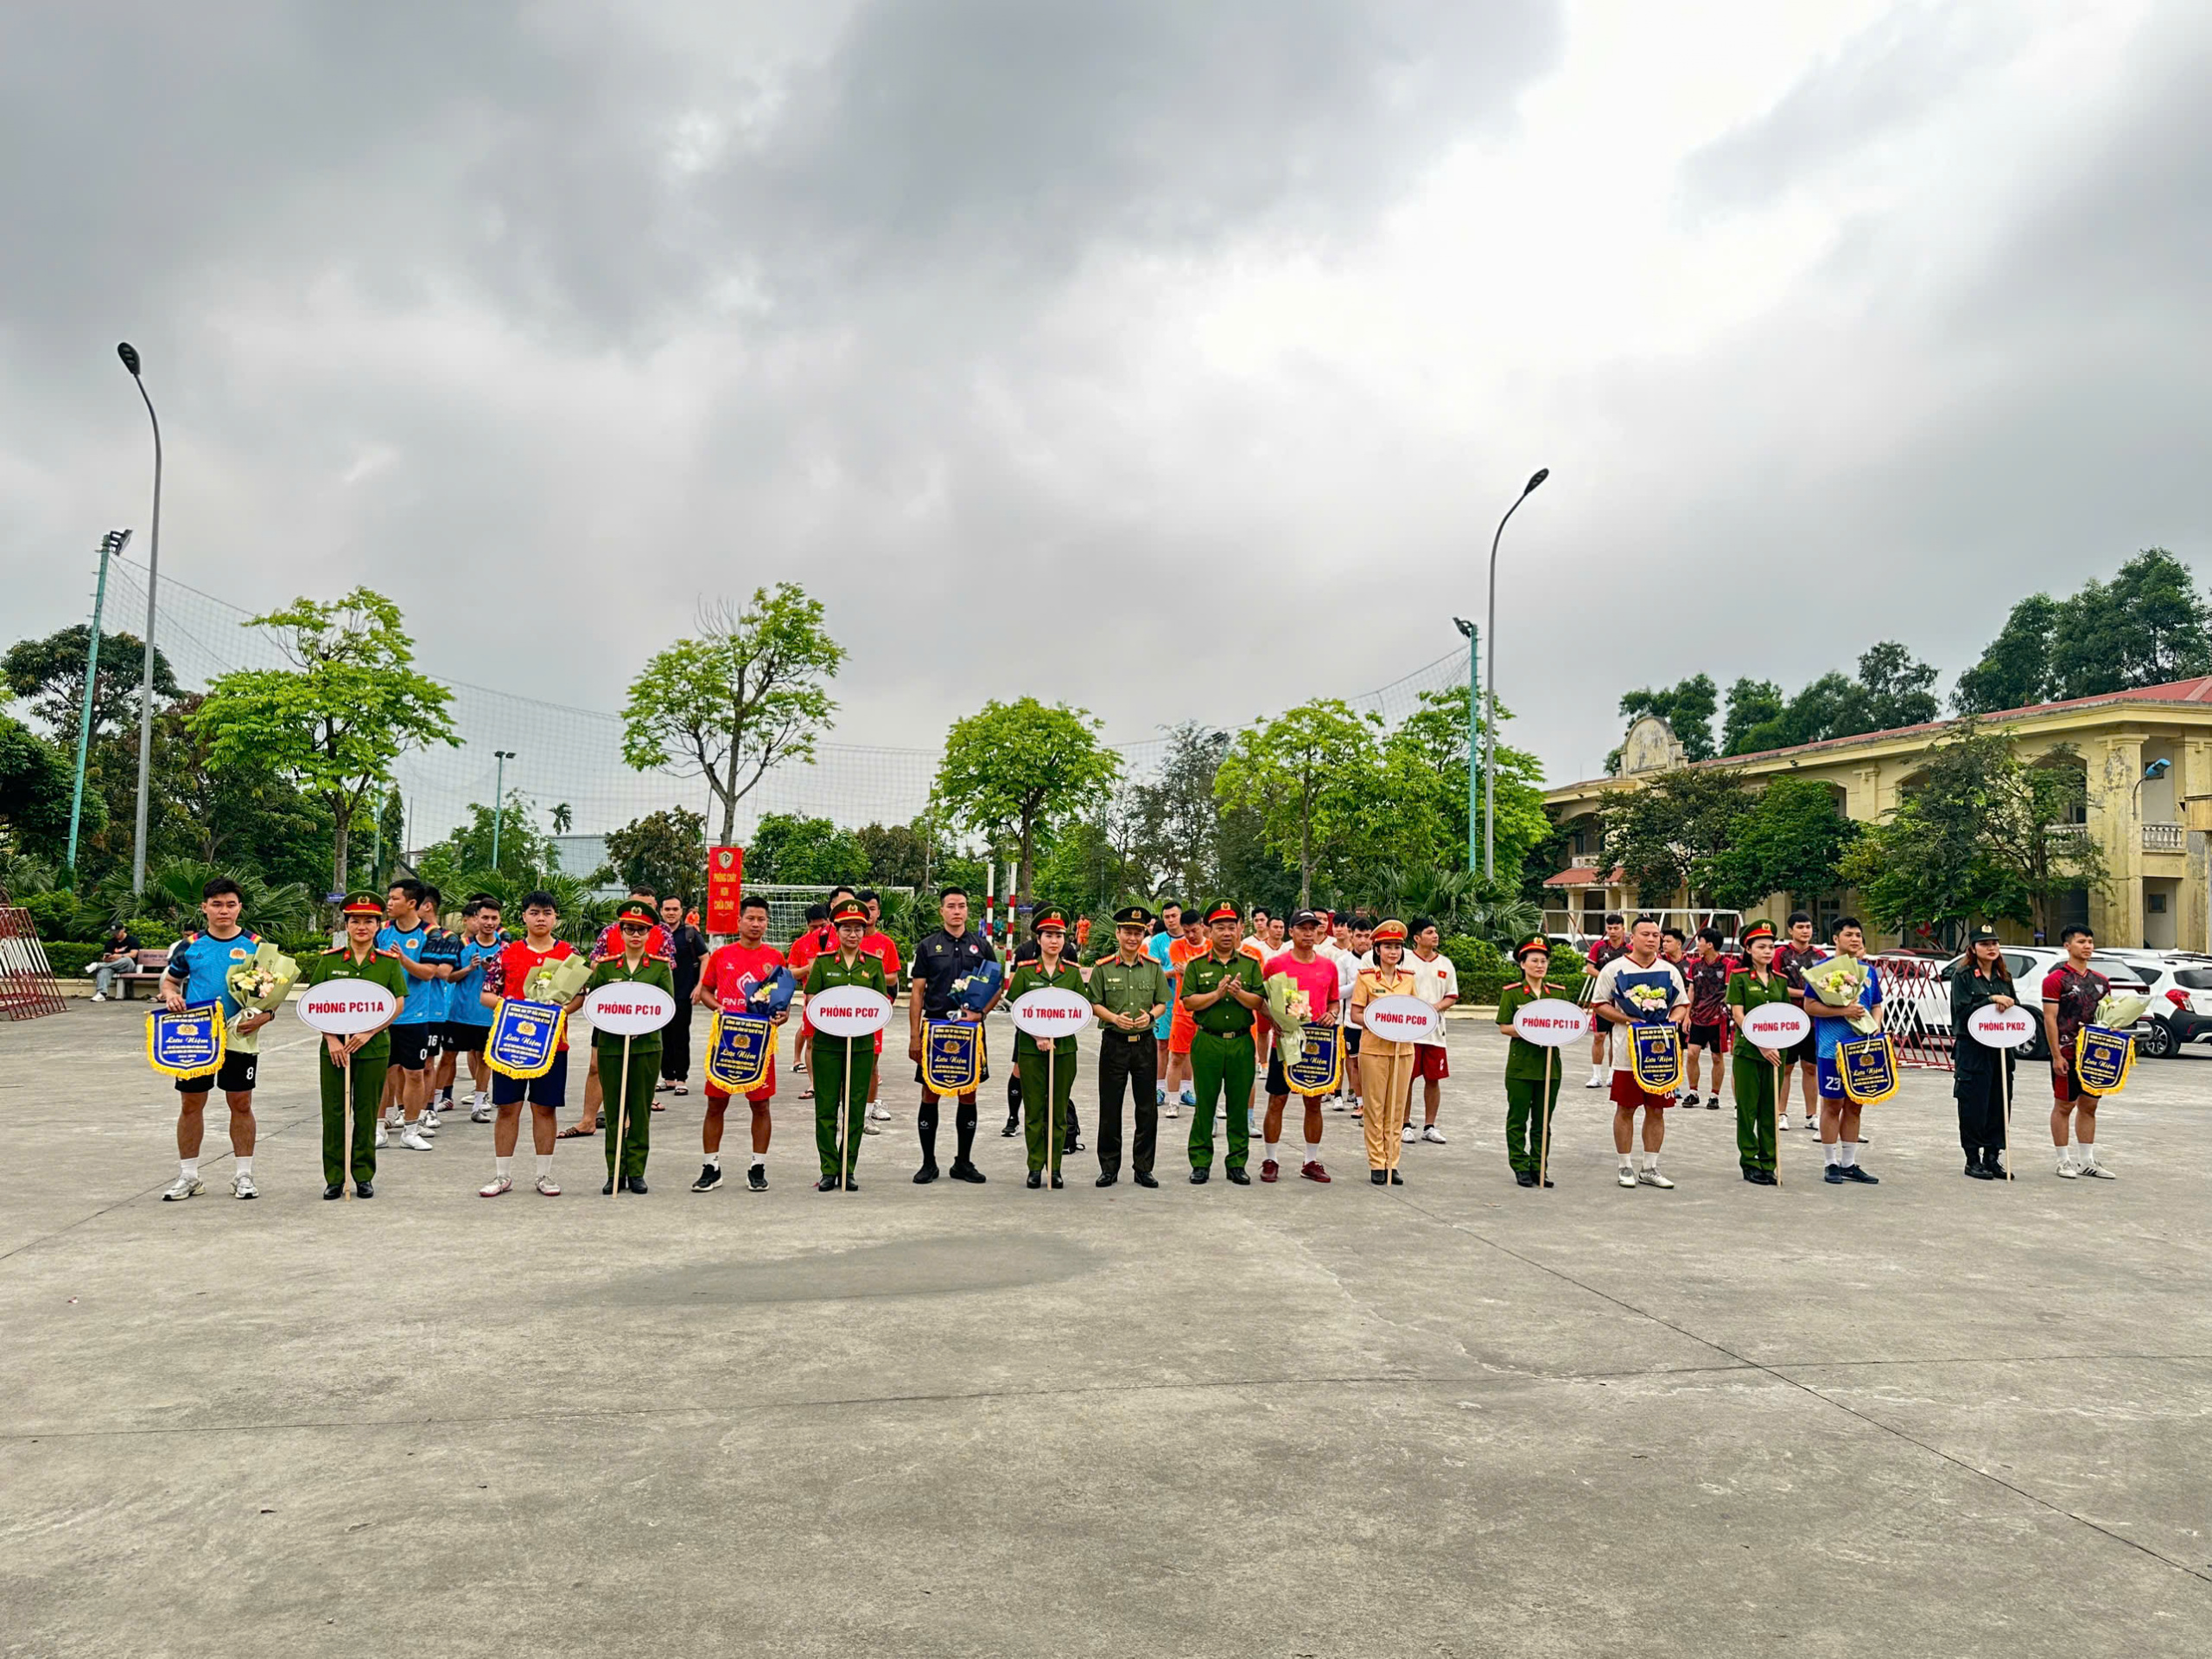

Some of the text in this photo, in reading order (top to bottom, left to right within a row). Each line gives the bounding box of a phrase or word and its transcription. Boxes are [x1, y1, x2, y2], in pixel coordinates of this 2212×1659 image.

[308, 1000, 384, 1014] PHÒNG PC11A
[597, 1001, 661, 1015] PHÒNG PC10
[820, 1005, 880, 1018] PHÒNG PC07
[1022, 1005, 1082, 1021] TỔ TRỌNG TÀI
[1375, 1011, 1427, 1025] PHÒNG PC08
[1522, 1016, 1580, 1029] PHÒNG PC11B
[1752, 1020, 1778, 1032] PHÒNG
[1979, 1020, 2025, 1031] PHÒNG PK02
[427, 1035, 438, 1047] 16
[245, 1066, 254, 1080] 8
[1825, 1076, 1841, 1090] 23
